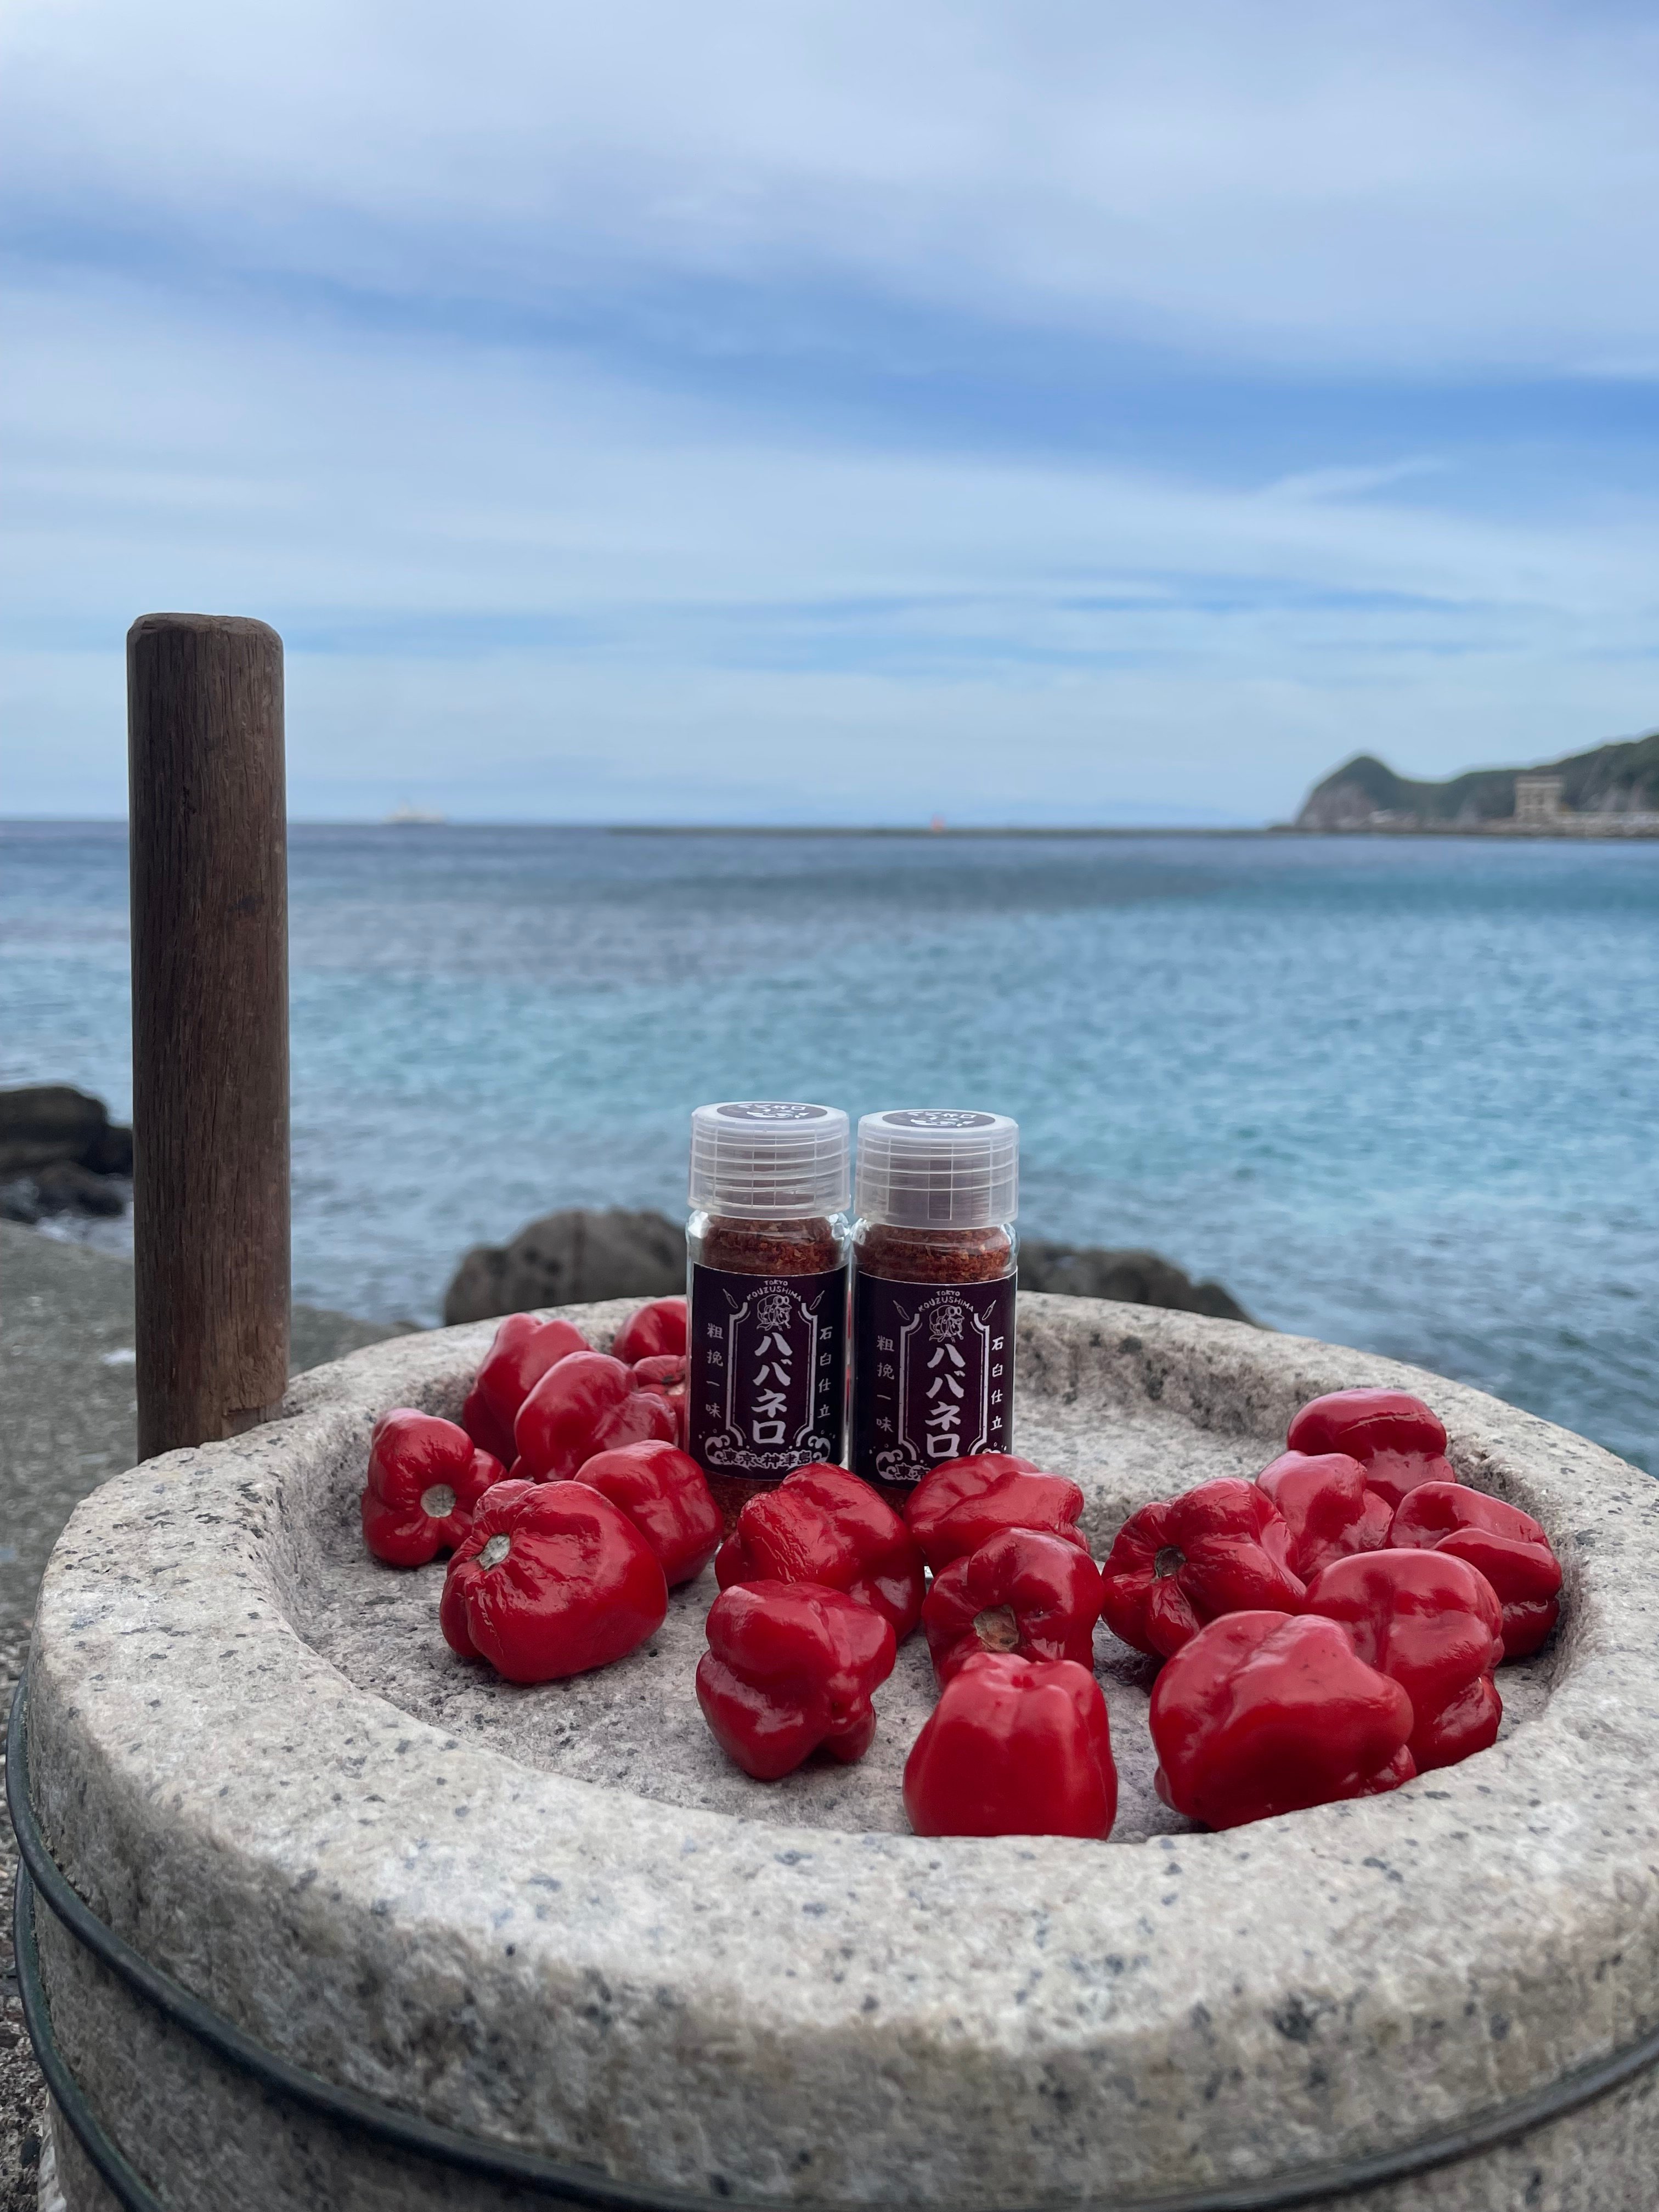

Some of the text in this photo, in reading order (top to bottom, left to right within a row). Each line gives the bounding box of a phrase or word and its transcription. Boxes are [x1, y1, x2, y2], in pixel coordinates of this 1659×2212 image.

[746, 1285, 802, 1302] KOUZUSHIMA
[918, 1296, 974, 1312] KOUZUSHIMA
[706, 1323, 724, 1419] 粗挽一味
[751, 1332, 793, 1444] ハバネロ
[817, 1325, 833, 1419] 石臼仕立
[876, 1335, 895, 1433] 粗挽一味
[925, 1343, 966, 1458] ハバネロ
[990, 1336, 1004, 1431] 石臼仕立
